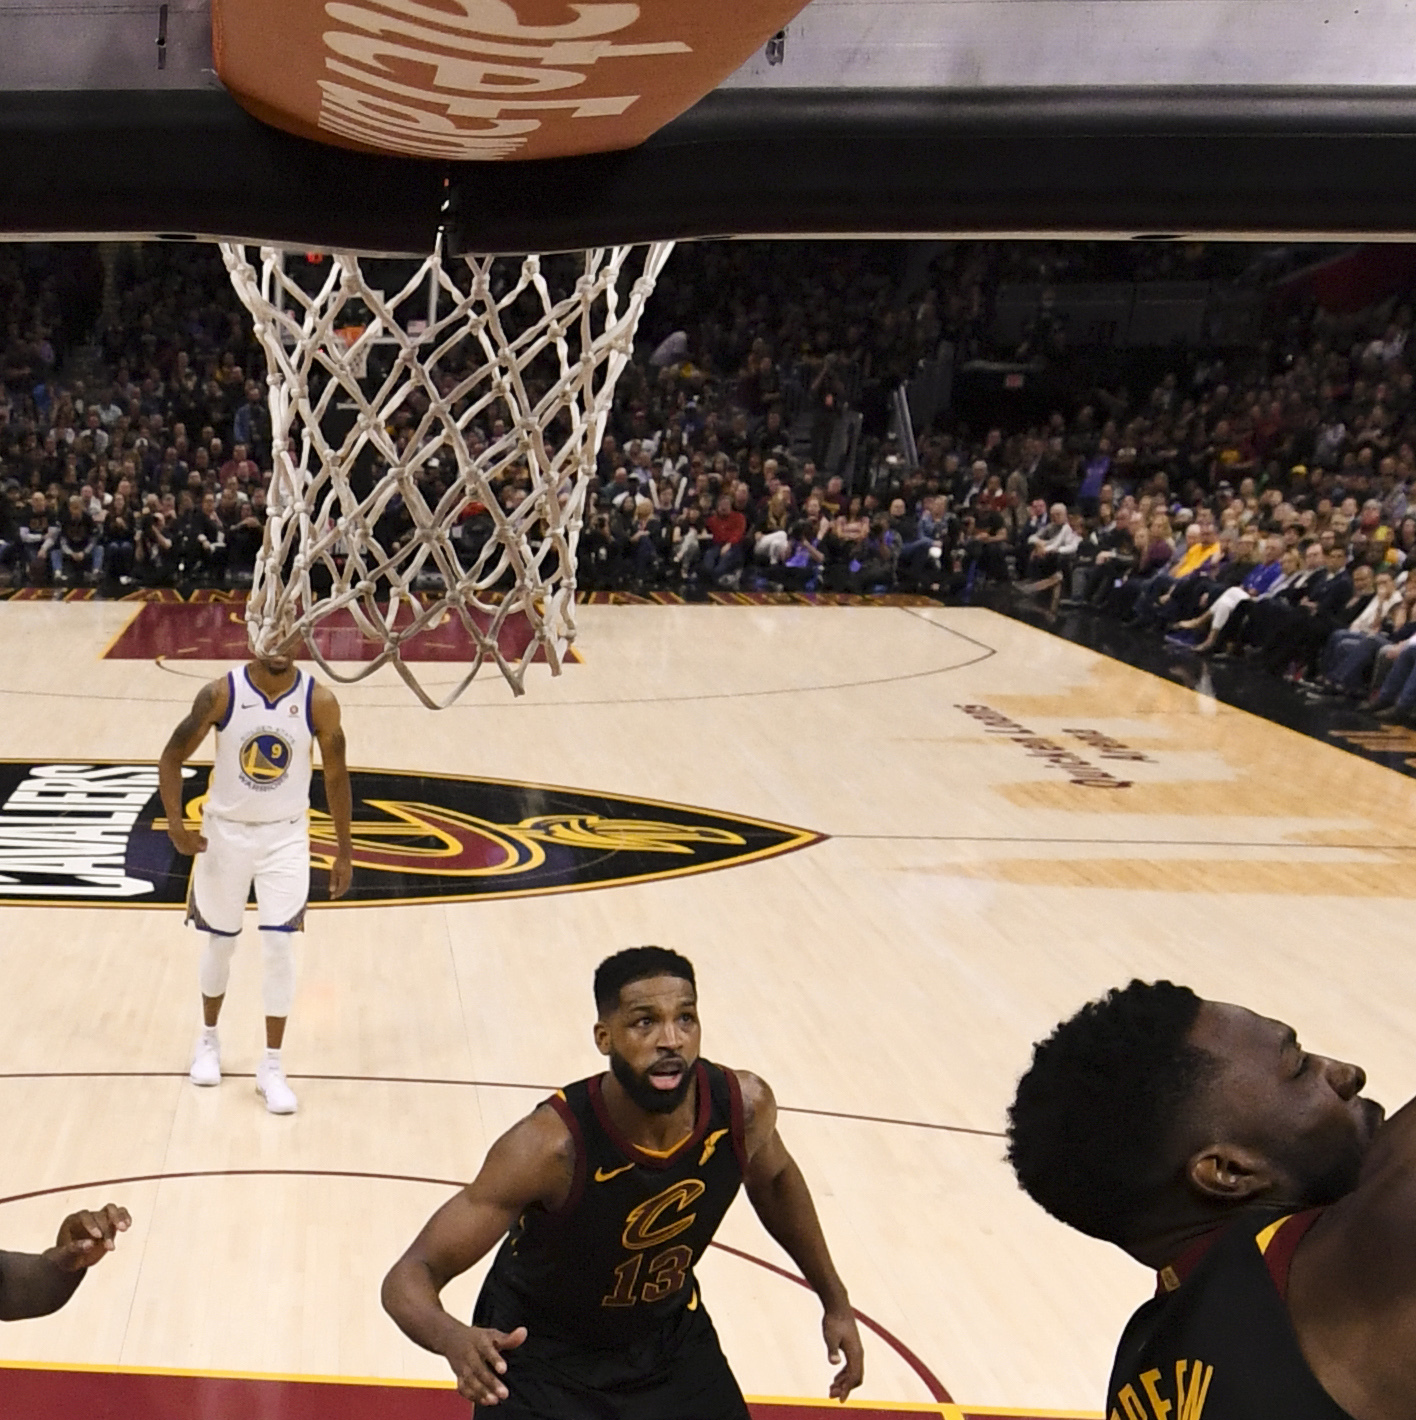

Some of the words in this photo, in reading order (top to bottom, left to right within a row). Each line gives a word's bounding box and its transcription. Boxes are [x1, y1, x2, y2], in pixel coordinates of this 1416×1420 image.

[317, 0, 693, 160] ateFarm
[271, 743, 282, 759] 9
[601, 1244, 693, 1307] 13
